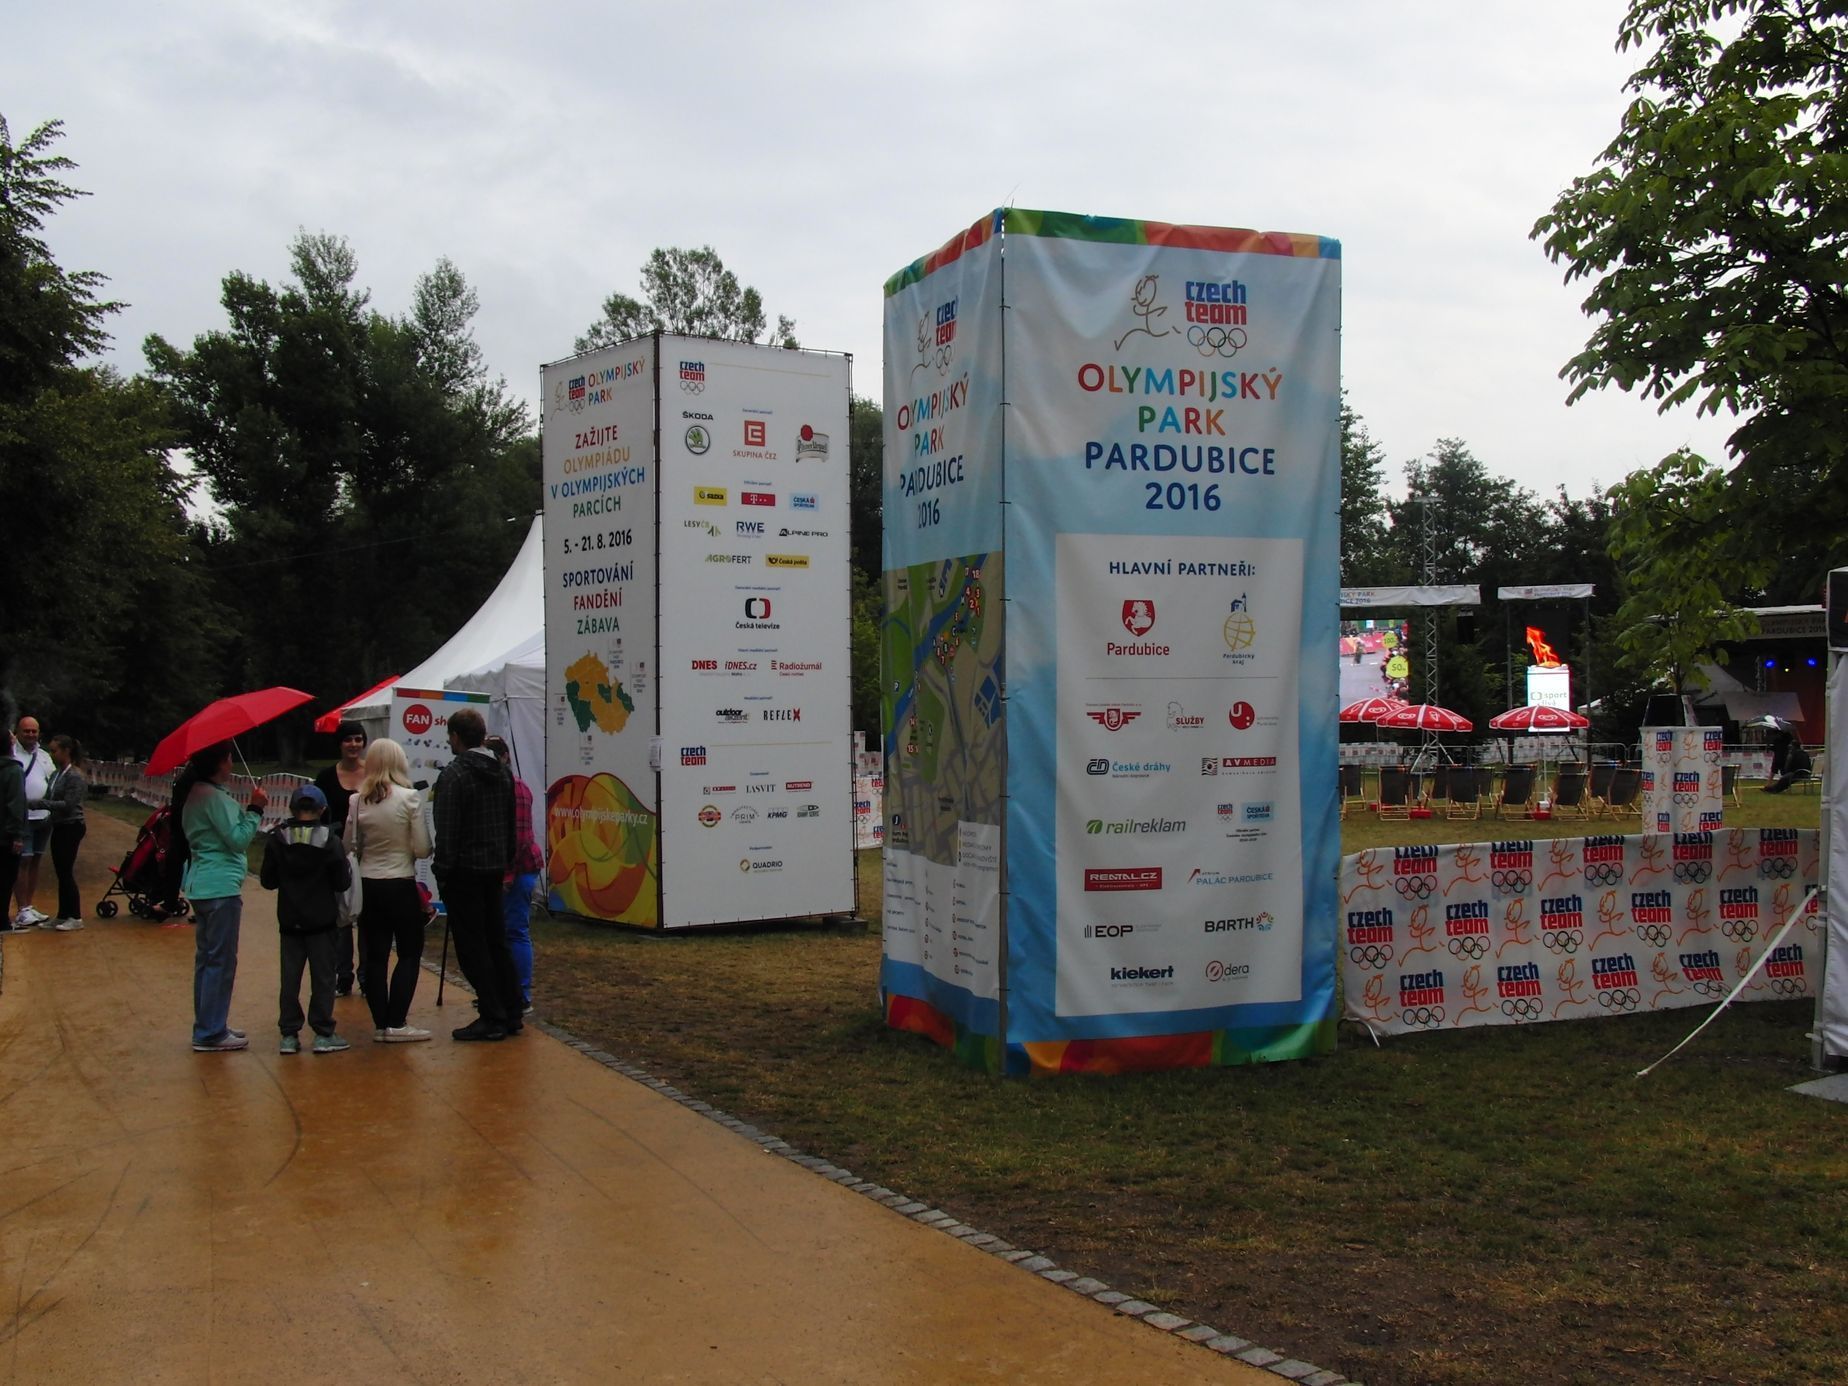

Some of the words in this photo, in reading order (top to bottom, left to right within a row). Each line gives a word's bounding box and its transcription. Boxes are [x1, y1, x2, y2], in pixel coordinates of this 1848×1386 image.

[1185, 280, 1246, 304] czech
[1185, 300, 1247, 325] team
[588, 356, 645, 388] OLYMPIJSKÝ
[680, 361, 705, 372] czech
[680, 371, 705, 381] team
[1078, 363, 1282, 402] OLYMPIJSKÝ
[589, 387, 613, 406] PARK
[682, 411, 714, 421] ŠKODA
[1138, 406, 1226, 436] PARK
[575, 425, 618, 449] ZAŽIJTE
[914, 425, 945, 457] PARK
[564, 446, 630, 474] OLYMPIÁDU
[732, 450, 762, 460] SKUPINA
[765, 450, 777, 460] ČEZ
[1085, 441, 1275, 475] PARDUBICE
[551, 485, 558, 499] V
[562, 466, 645, 498] OLYMPIJSKÝCH
[1145, 482, 1221, 511] 2016
[573, 495, 621, 518] PARCÍCH
[736, 521, 764, 534] RWE
[582, 536, 594, 551] 21.
[597, 533, 606, 549] 8.
[609, 529, 632, 547] 2016
[705, 554, 752, 564] AGROFERT
[1109, 559, 1172, 576] HLAVNÍ
[1178, 560, 1256, 576] PARTNEŘI:
[563, 560, 633, 588] SPORTOVÁNÍ
[574, 587, 622, 611] FANDĚNÍ
[577, 615, 620, 635] ZÁBAVA
[735, 621, 754, 629] Česká
[755, 622, 780, 630] televize
[1107, 642, 1170, 656] Pardubice
[692, 660, 717, 670] DNES
[725, 660, 757, 671] iDNES.cz
[779, 661, 822, 671] Radiožurnál
[1544, 691, 1567, 700] sport
[406, 714, 430, 725] FAN
[763, 708, 800, 721] REFLEX
[1176, 714, 1205, 725] SLUŽBY
[681, 746, 706, 757] czech
[681, 756, 706, 766] team
[1112, 760, 1140, 772] České
[1143, 760, 1171, 773] dráhy
[1674, 771, 1699, 782] czech
[746, 784, 776, 793] LASVIT
[1673, 781, 1699, 792] team
[768, 811, 787, 819] KPMG
[1106, 818, 1186, 834] railreklam
[1583, 845, 1624, 863] team
[1672, 844, 1713, 860] team
[1759, 840, 1798, 857] team
[752, 860, 783, 869] QUADRIO
[1394, 857, 1437, 876] team
[1490, 851, 1533, 869] team
[1196, 875, 1226, 885] PALÁC
[1229, 873, 1273, 884] PARDUBICE
[1632, 889, 1671, 908] czech
[1720, 885, 1758, 904] czech
[1446, 900, 1488, 920] czech
[1541, 894, 1583, 915] czech
[1720, 902, 1758, 920] team
[1348, 907, 1393, 927] czech
[1540, 912, 1583, 930] team
[1631, 907, 1672, 923] team
[1095, 925, 1133, 938] EOP
[1204, 917, 1254, 933] BARTH
[1445, 918, 1489, 936] team
[1347, 926, 1394, 945] team
[1592, 953, 1635, 975] czech
[1679, 950, 1720, 968] czech
[1111, 965, 1174, 980] kiekert
[1224, 963, 1250, 977] dera
[1497, 961, 1540, 982] czech
[1682, 967, 1724, 982] team
[1765, 960, 1804, 979] team
[1400, 969, 1444, 990] czech
[1497, 979, 1541, 998] team
[1592, 971, 1638, 989] team
[1400, 988, 1444, 1007] team
